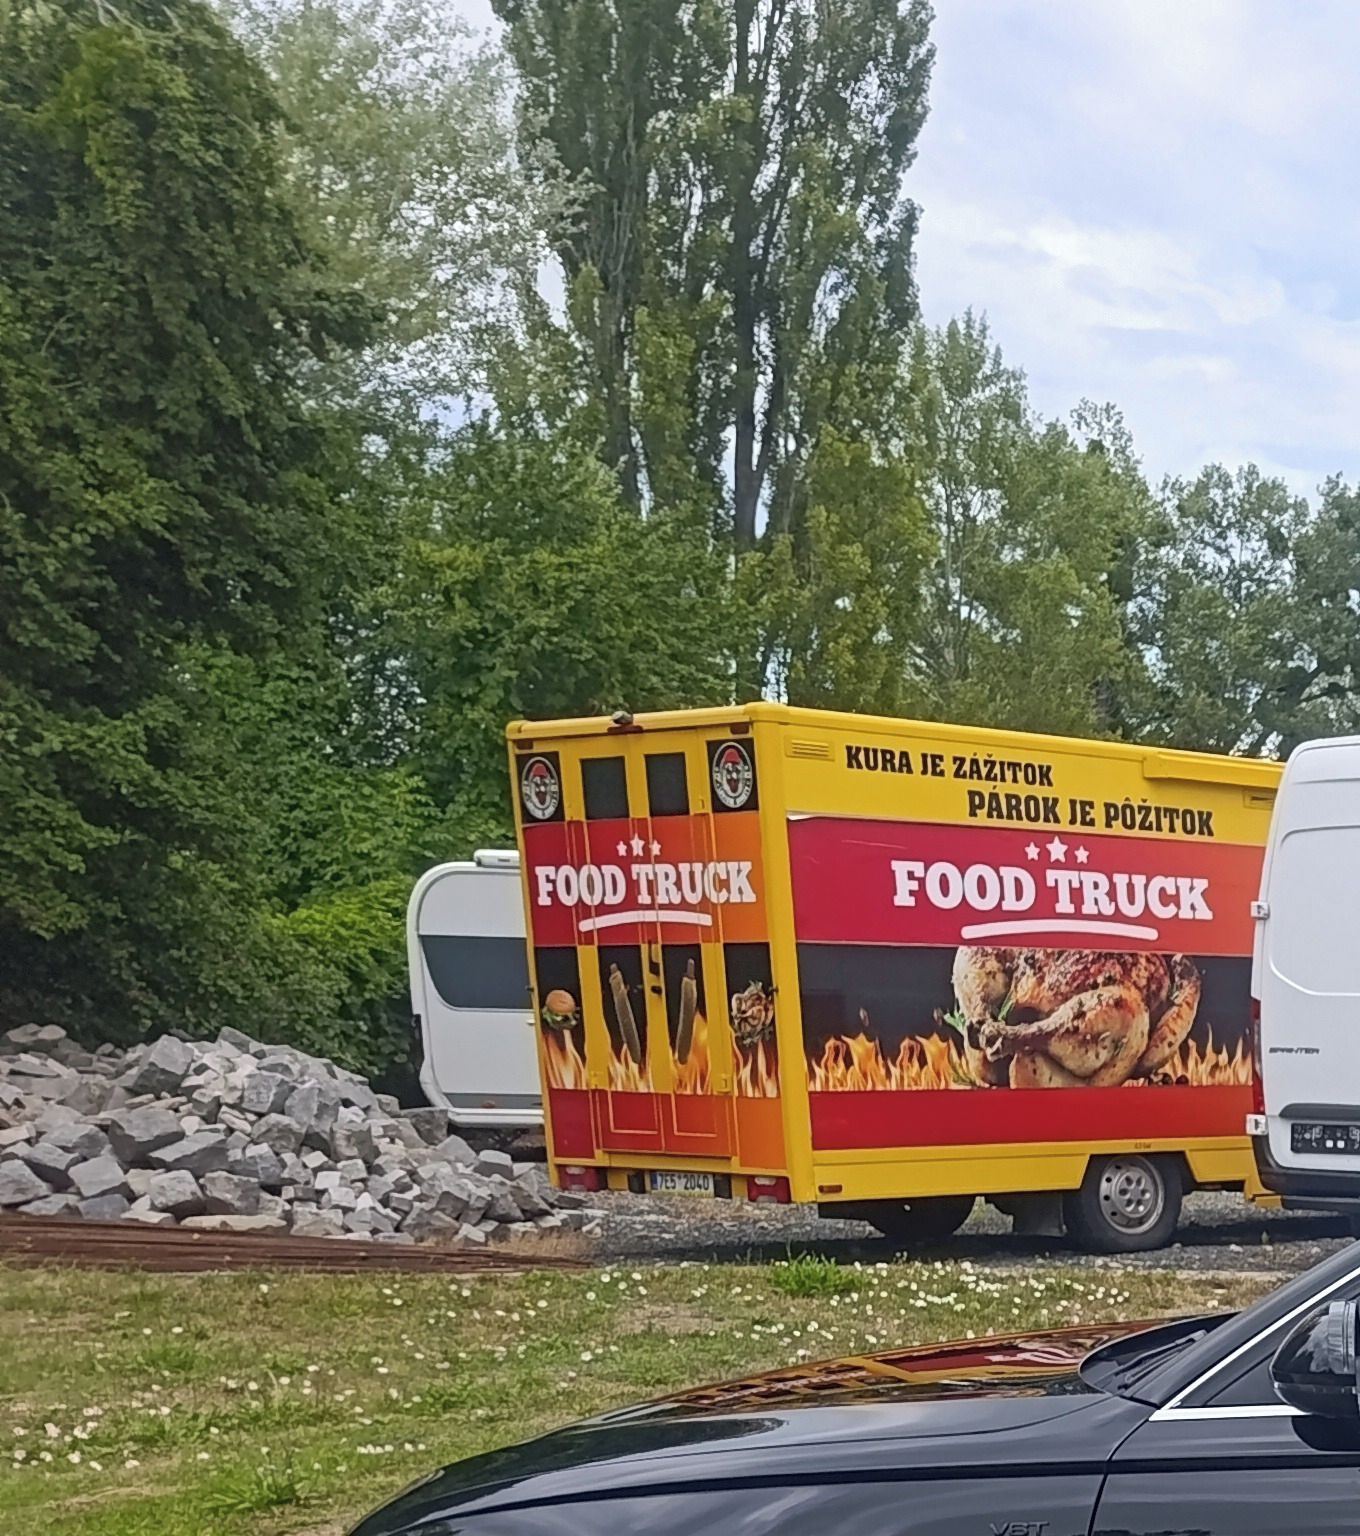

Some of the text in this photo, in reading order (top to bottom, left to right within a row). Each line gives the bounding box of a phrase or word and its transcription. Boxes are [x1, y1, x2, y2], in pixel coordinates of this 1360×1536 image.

[845, 745, 1053, 787] KURA JE ZÁŽITOK
[967, 785, 1214, 837] PÁROK JE PÔŽITOK
[534, 861, 757, 906] FOOD TRUCK
[891, 860, 1213, 920] FOOD TRUCK
[659, 1173, 710, 1190] 7E5 2040
